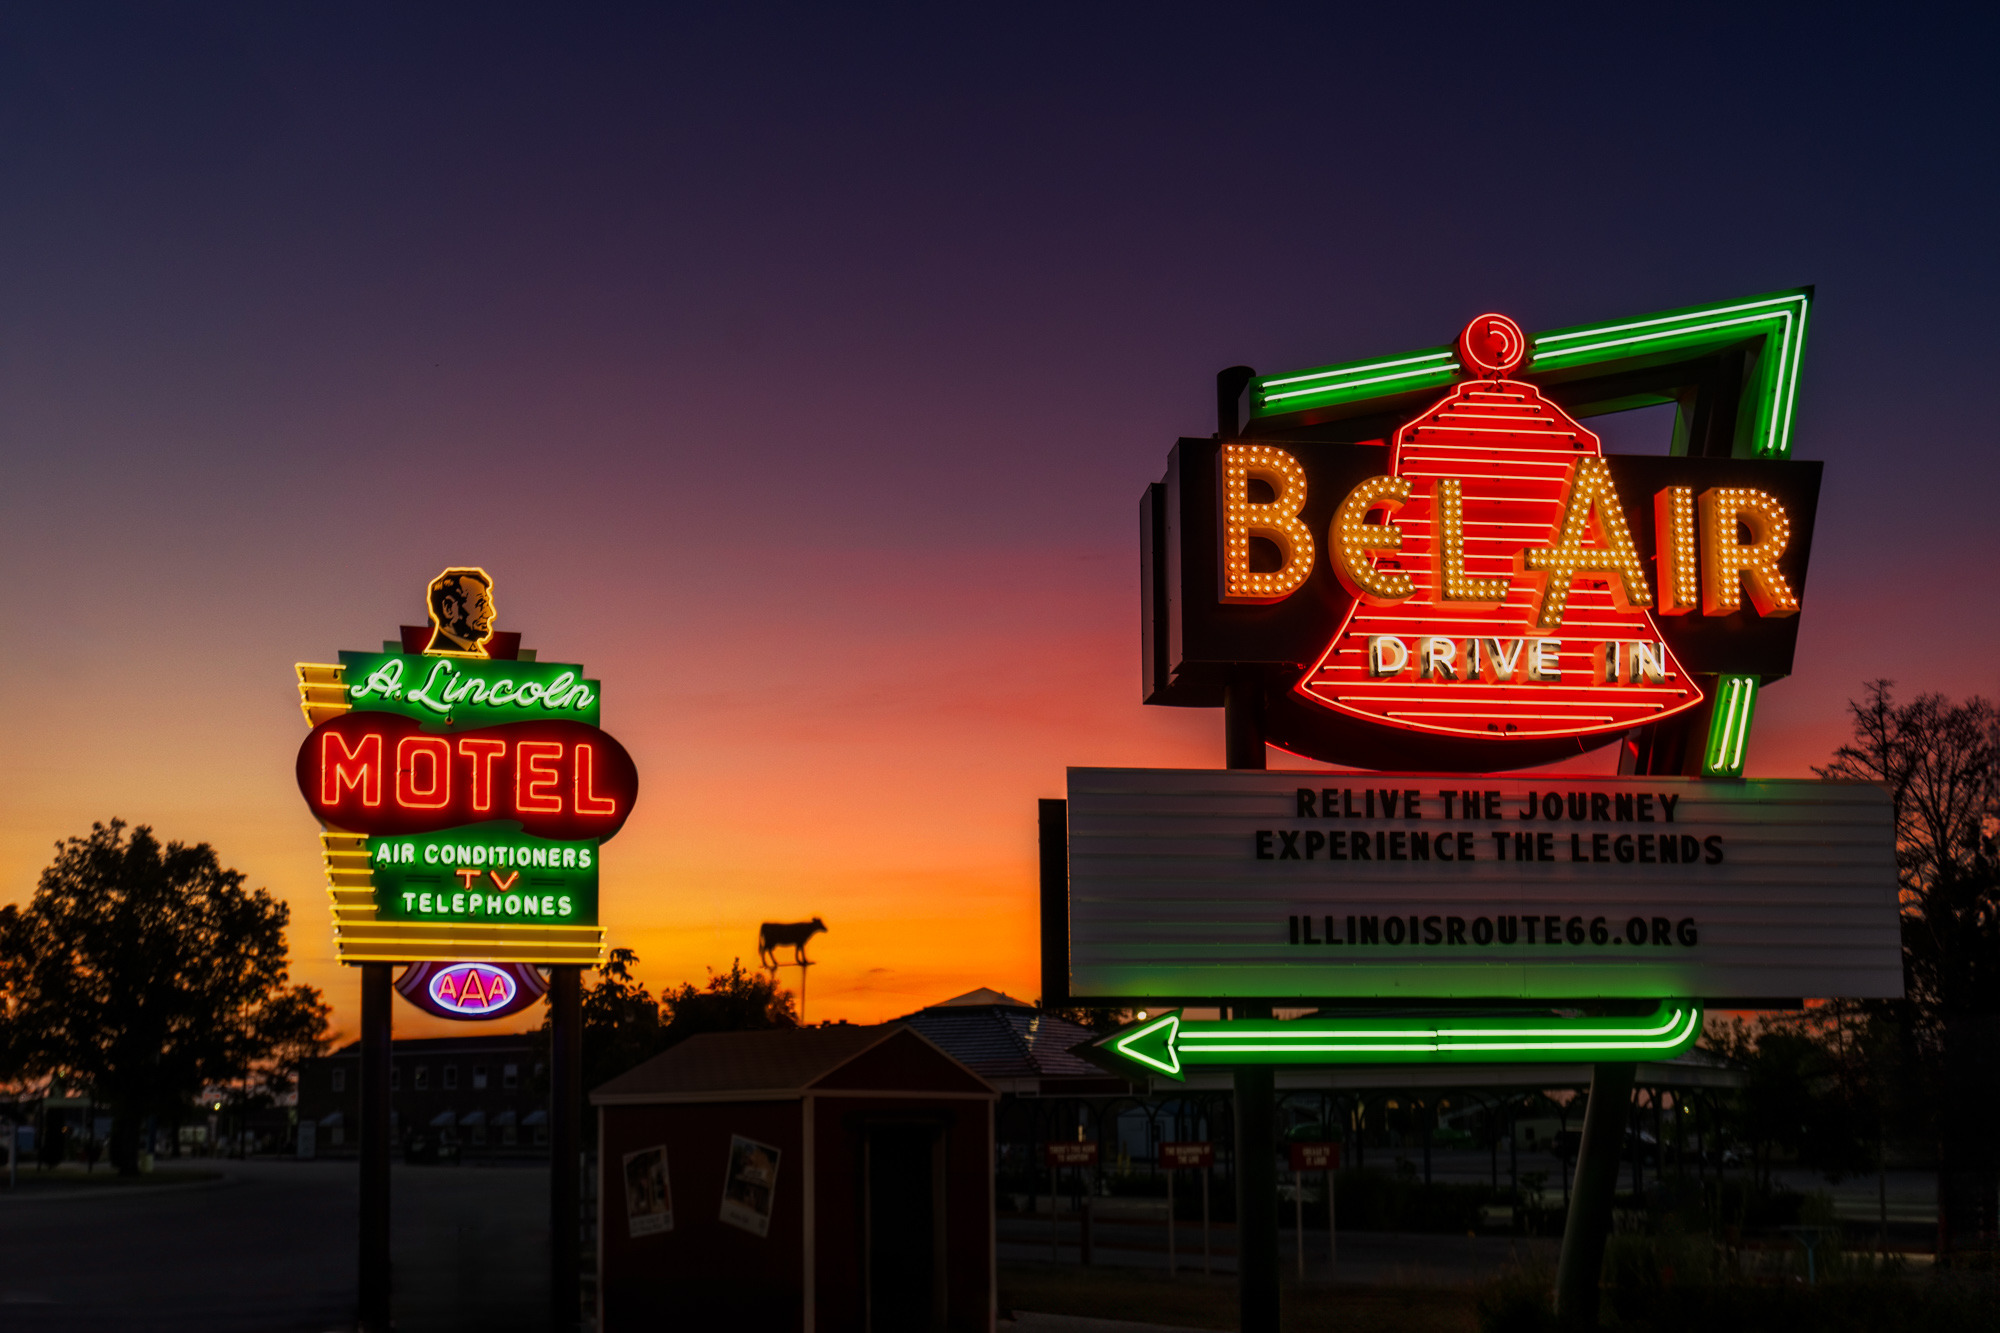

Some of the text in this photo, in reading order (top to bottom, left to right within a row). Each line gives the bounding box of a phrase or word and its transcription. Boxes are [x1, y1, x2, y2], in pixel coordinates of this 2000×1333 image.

[1369, 636, 1666, 684] DRIVE IN
[350, 659, 595, 712] A. Lincoln
[320, 731, 616, 815] MOTEL
[1296, 788, 1679, 823] RELIVE THE JOURNEY
[376, 843, 592, 869] AIR CONDITIONERS
[1255, 830, 1724, 865] EXPERIENCE THE LEGENDS
[402, 893, 572, 916] TELEPHONES
[1289, 916, 1698, 946] ILLINOISROUTE66.ORG
[437, 969, 508, 1009] AAA
